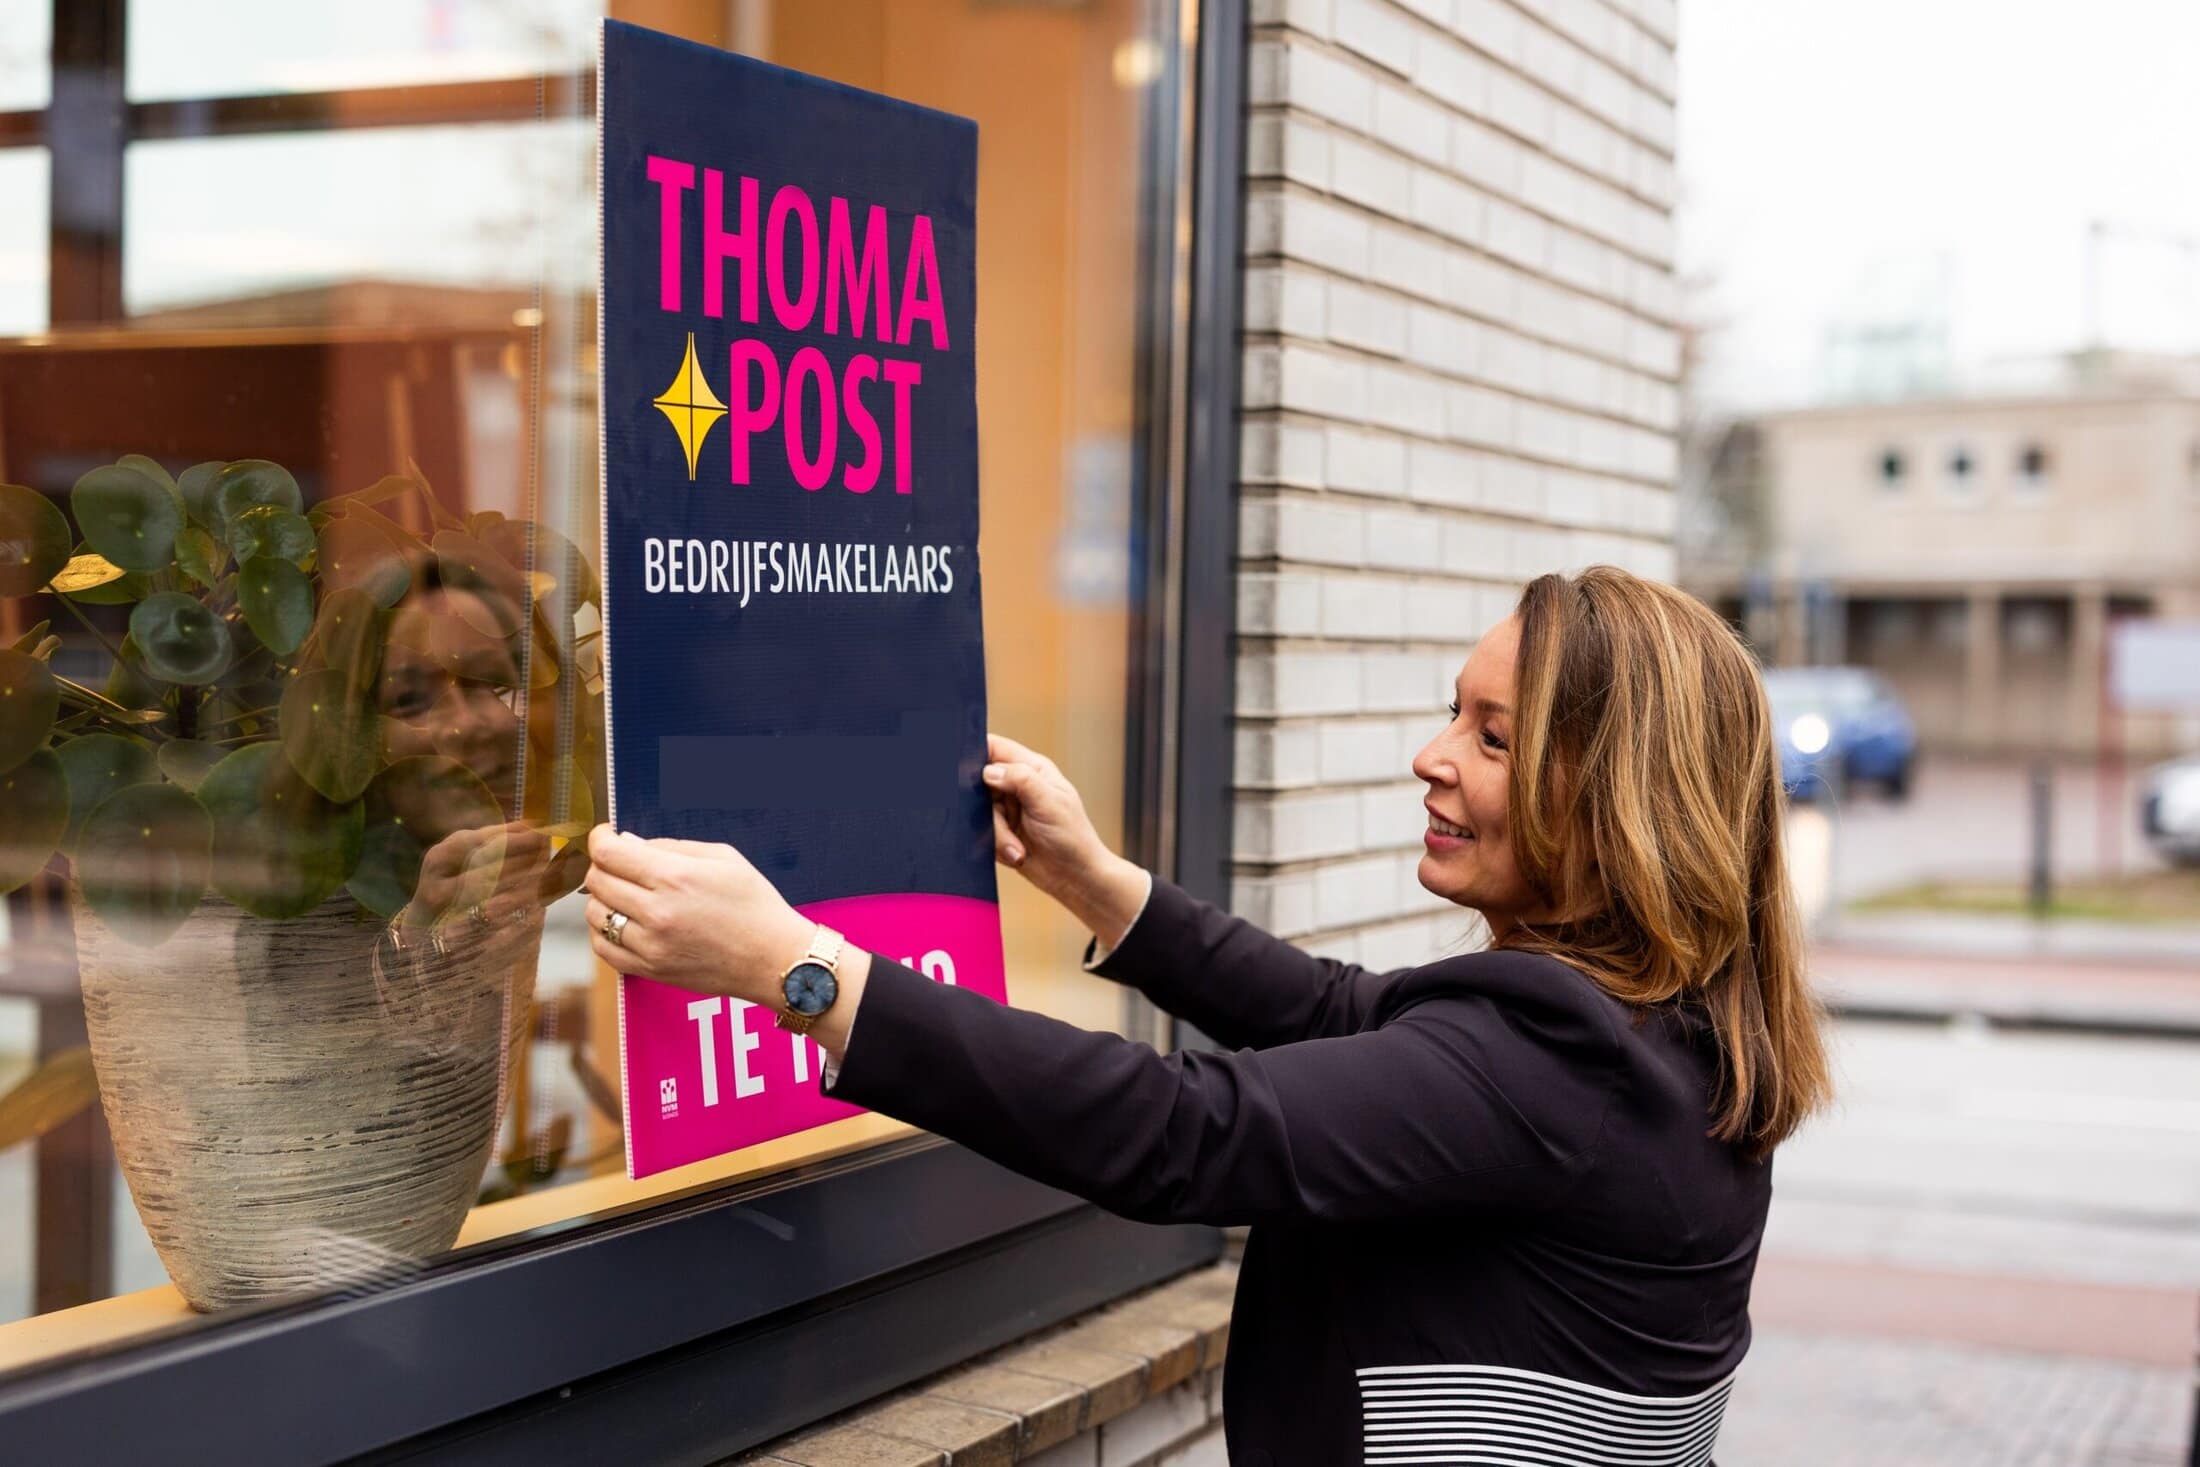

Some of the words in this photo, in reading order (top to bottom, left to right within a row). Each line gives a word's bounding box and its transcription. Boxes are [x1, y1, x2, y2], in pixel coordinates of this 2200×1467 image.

[647, 155, 950, 351] THOMA
[731, 338, 921, 494] POST
[644, 538, 954, 608] BEDRIJFSMAKELAARS
[687, 996, 765, 1107] TE
